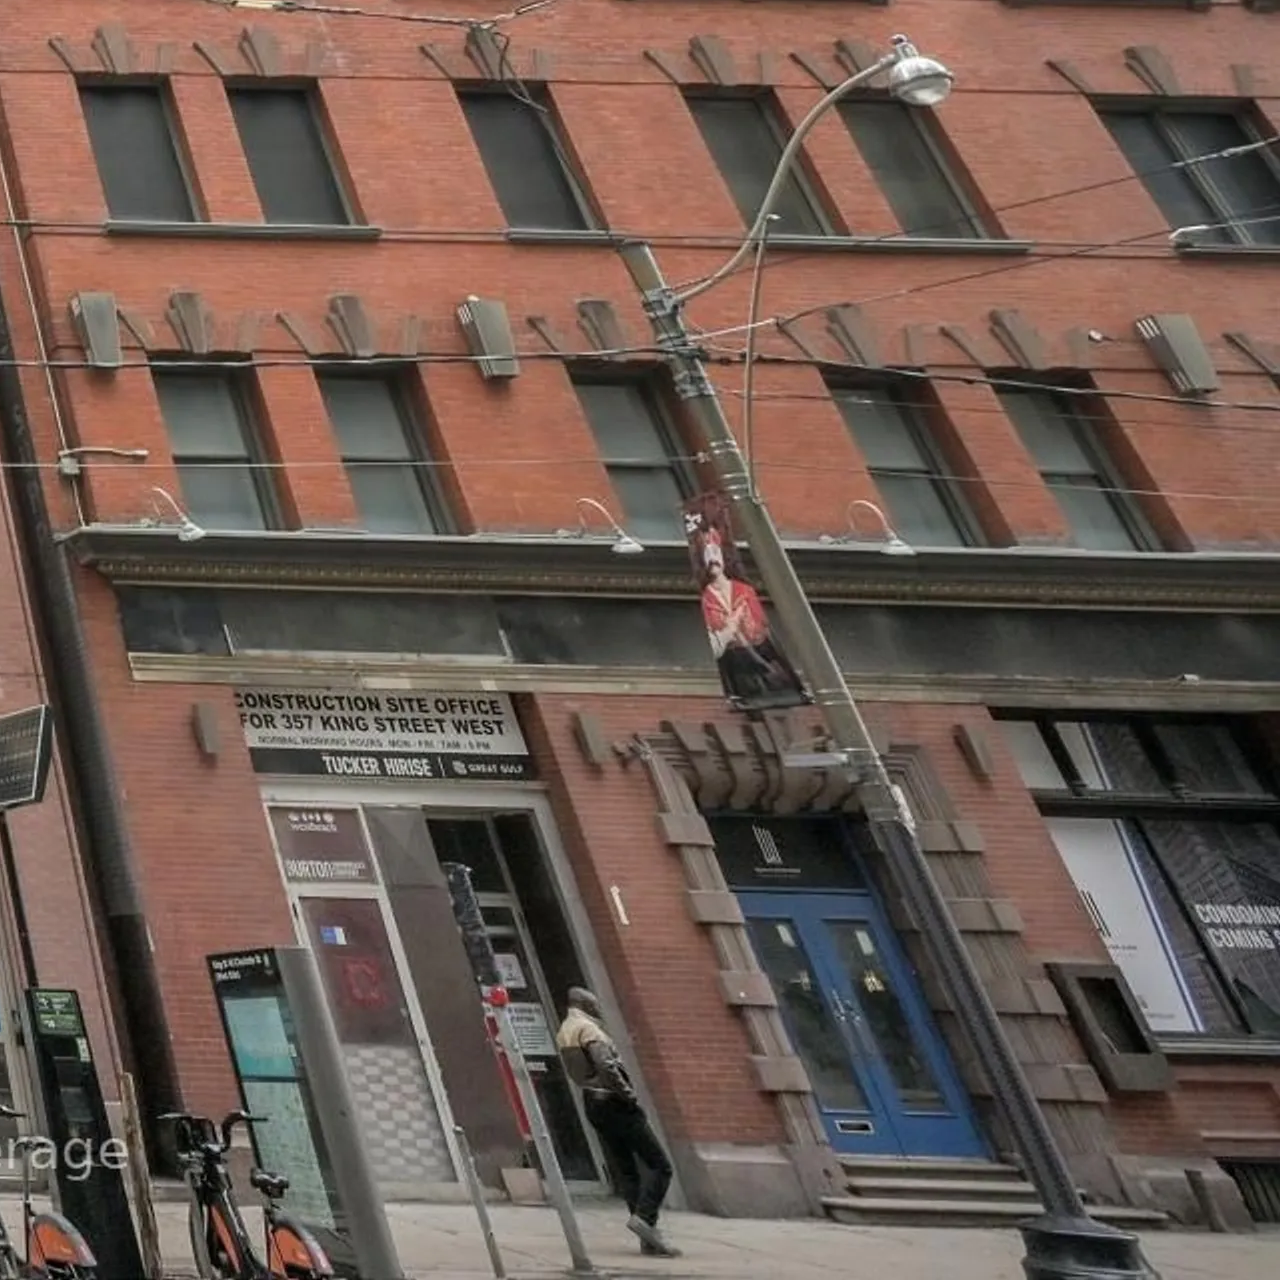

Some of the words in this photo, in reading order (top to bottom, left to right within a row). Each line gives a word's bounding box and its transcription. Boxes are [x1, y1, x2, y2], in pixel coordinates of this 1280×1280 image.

[386, 697, 430, 714] SITE
[434, 698, 504, 716] OFFICE
[239, 712, 278, 729] FOR
[281, 714, 313, 730] 357
[320, 715, 369, 732] KING
[374, 717, 447, 734] STREET
[451, 719, 505, 736] WEST
[322, 755, 382, 775] TUCKER
[1195, 903, 1280, 925] CONDOMIN
[1207, 927, 1276, 950] COMING
